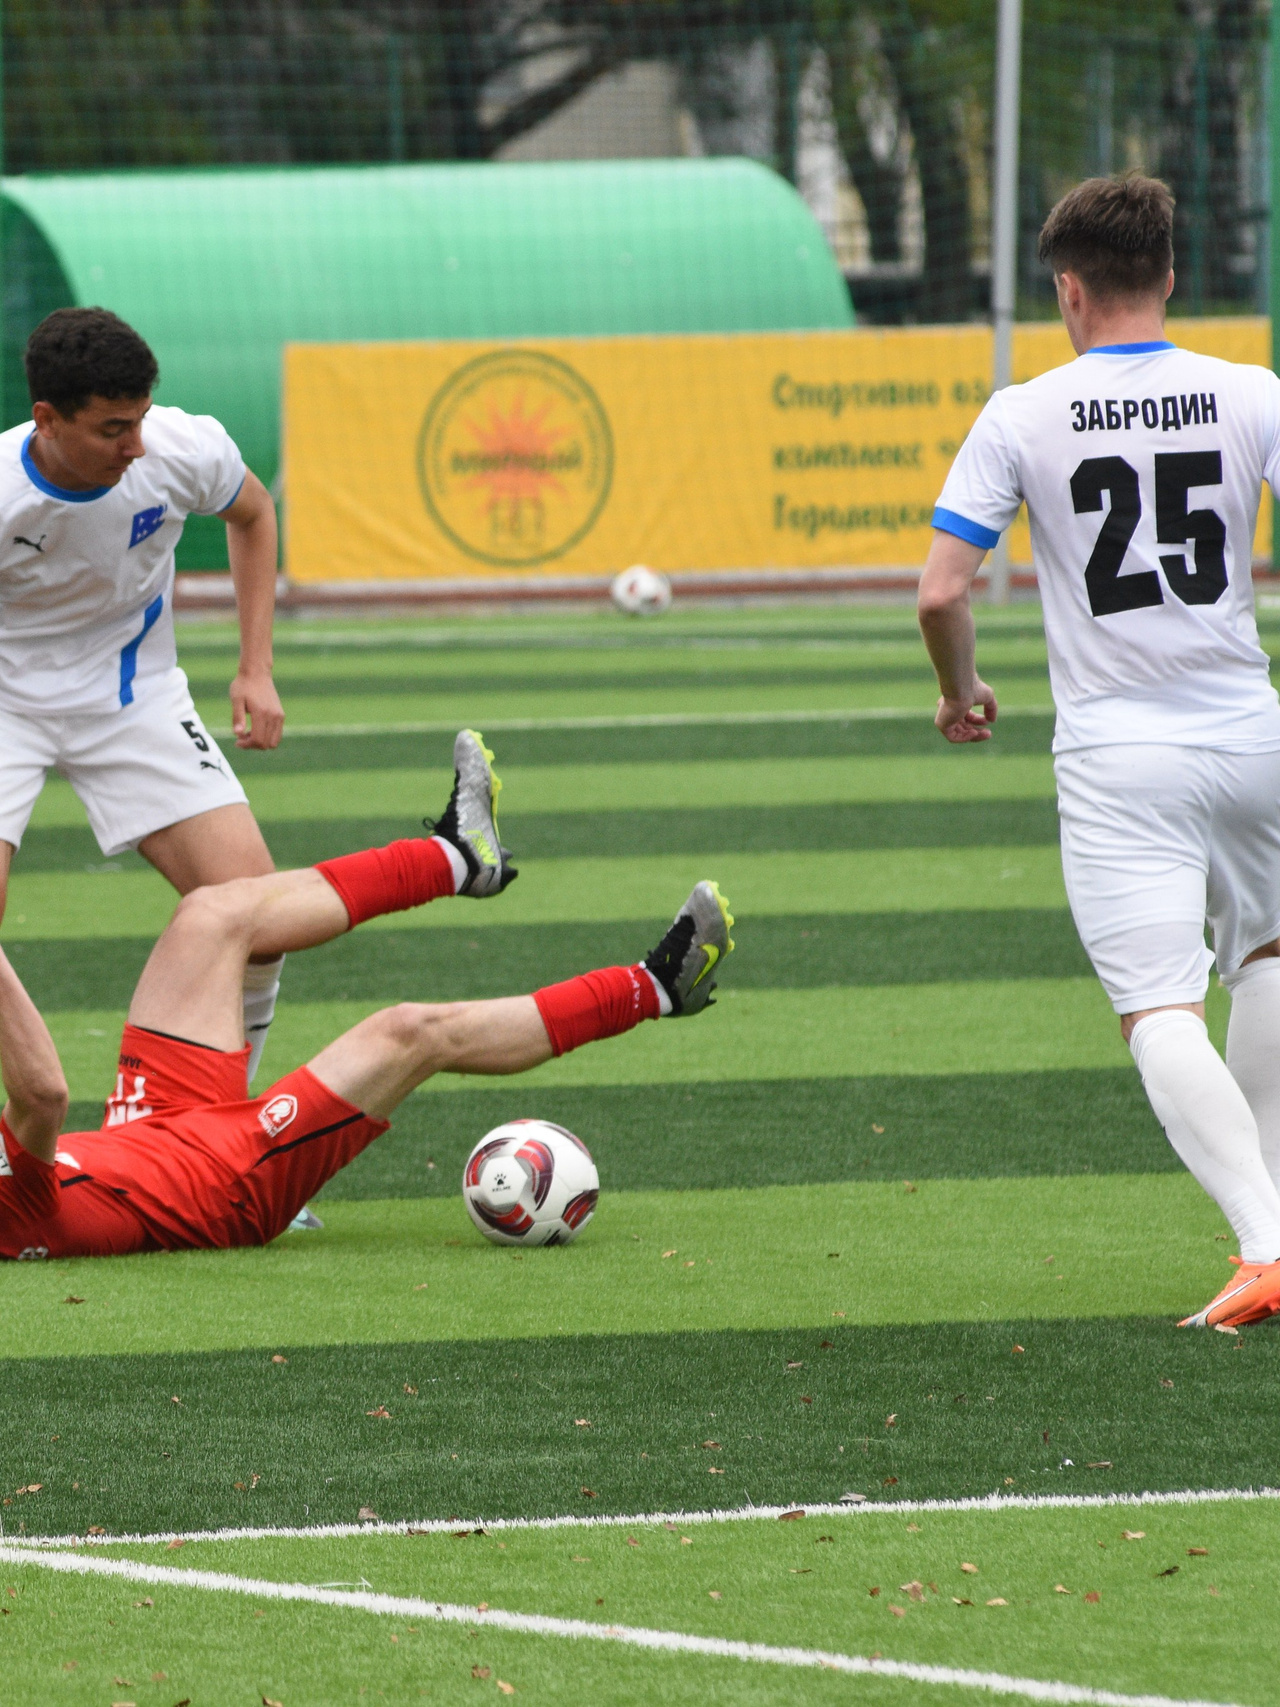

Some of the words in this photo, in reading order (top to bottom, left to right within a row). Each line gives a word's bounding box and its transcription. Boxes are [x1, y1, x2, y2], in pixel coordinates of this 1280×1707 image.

[1070, 393, 1218, 432] ЗАБРОДИН
[1070, 450, 1229, 618] 25
[181, 720, 210, 752] 5
